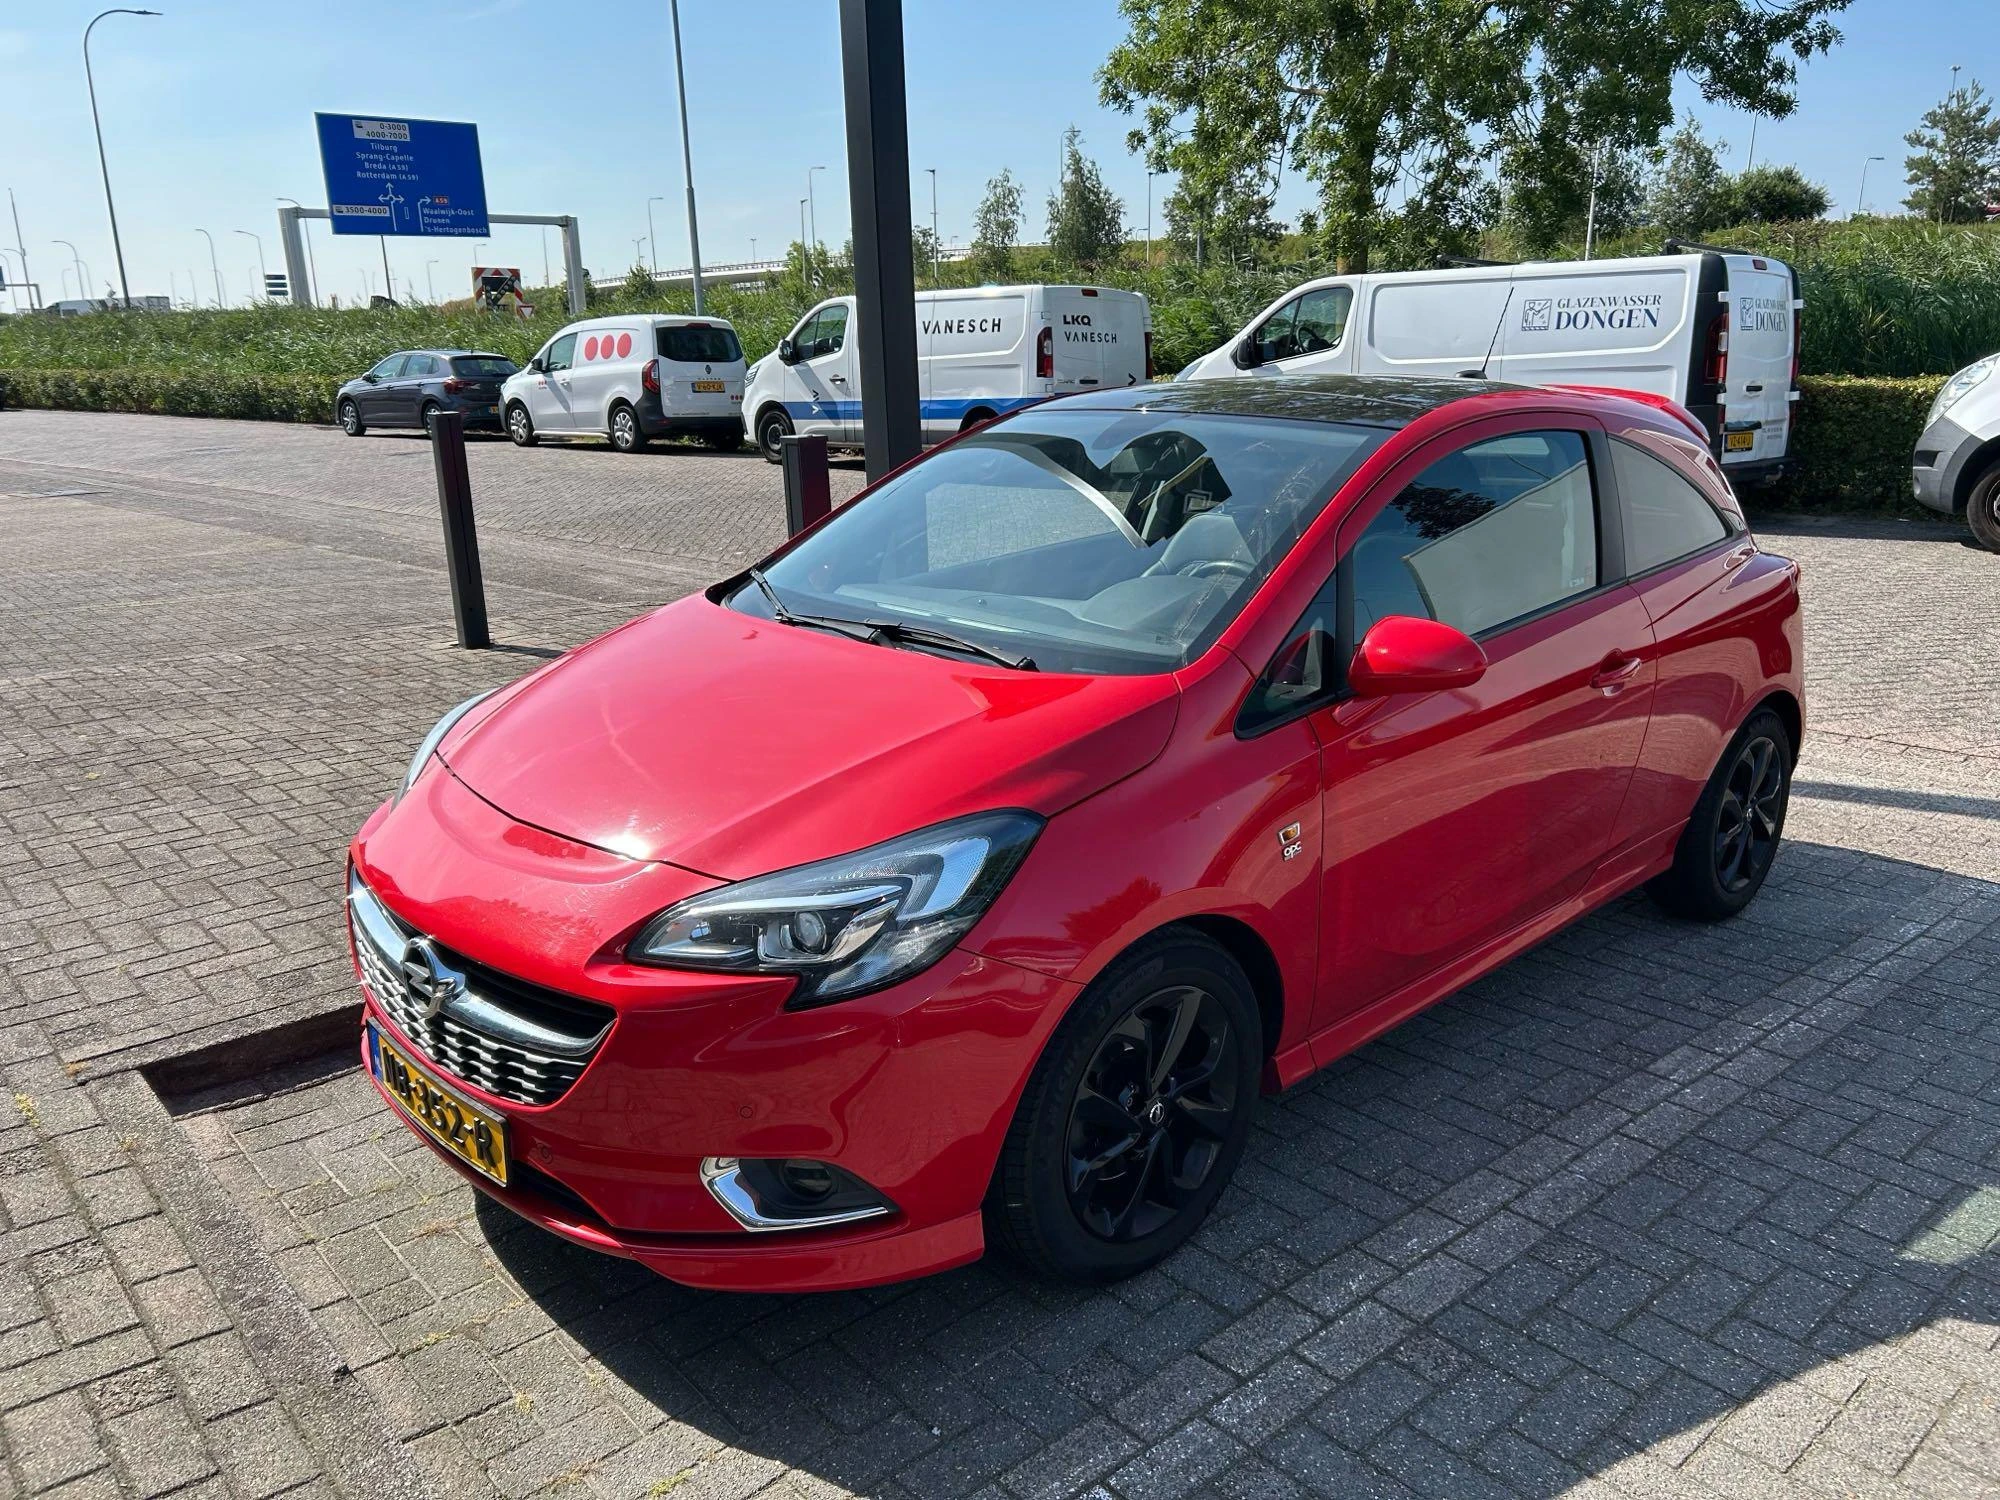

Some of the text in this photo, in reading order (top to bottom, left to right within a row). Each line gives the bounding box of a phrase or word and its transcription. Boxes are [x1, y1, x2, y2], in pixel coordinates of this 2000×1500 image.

[379, 122, 407, 131] 0-3000
[366, 131, 408, 140] 4000-7000
[370, 142, 398, 153] Tilburg
[356, 152, 414, 162] Sprang-Capelle
[364, 162, 387, 170] Breda
[356, 171, 397, 180] Rotterdam
[345, 206, 388, 215] 3500-4000
[423, 208, 474, 218] Waalwijk-Oost
[1557, 294, 1661, 309] GLAZENWASSER
[1063, 314, 1092, 326] LKQ
[1555, 308, 1661, 330] DONGEN
[1755, 311, 1787, 332] DONGEN
[922, 318, 1002, 335] VANESCH
[1064, 331, 1117, 344] VANESCH
